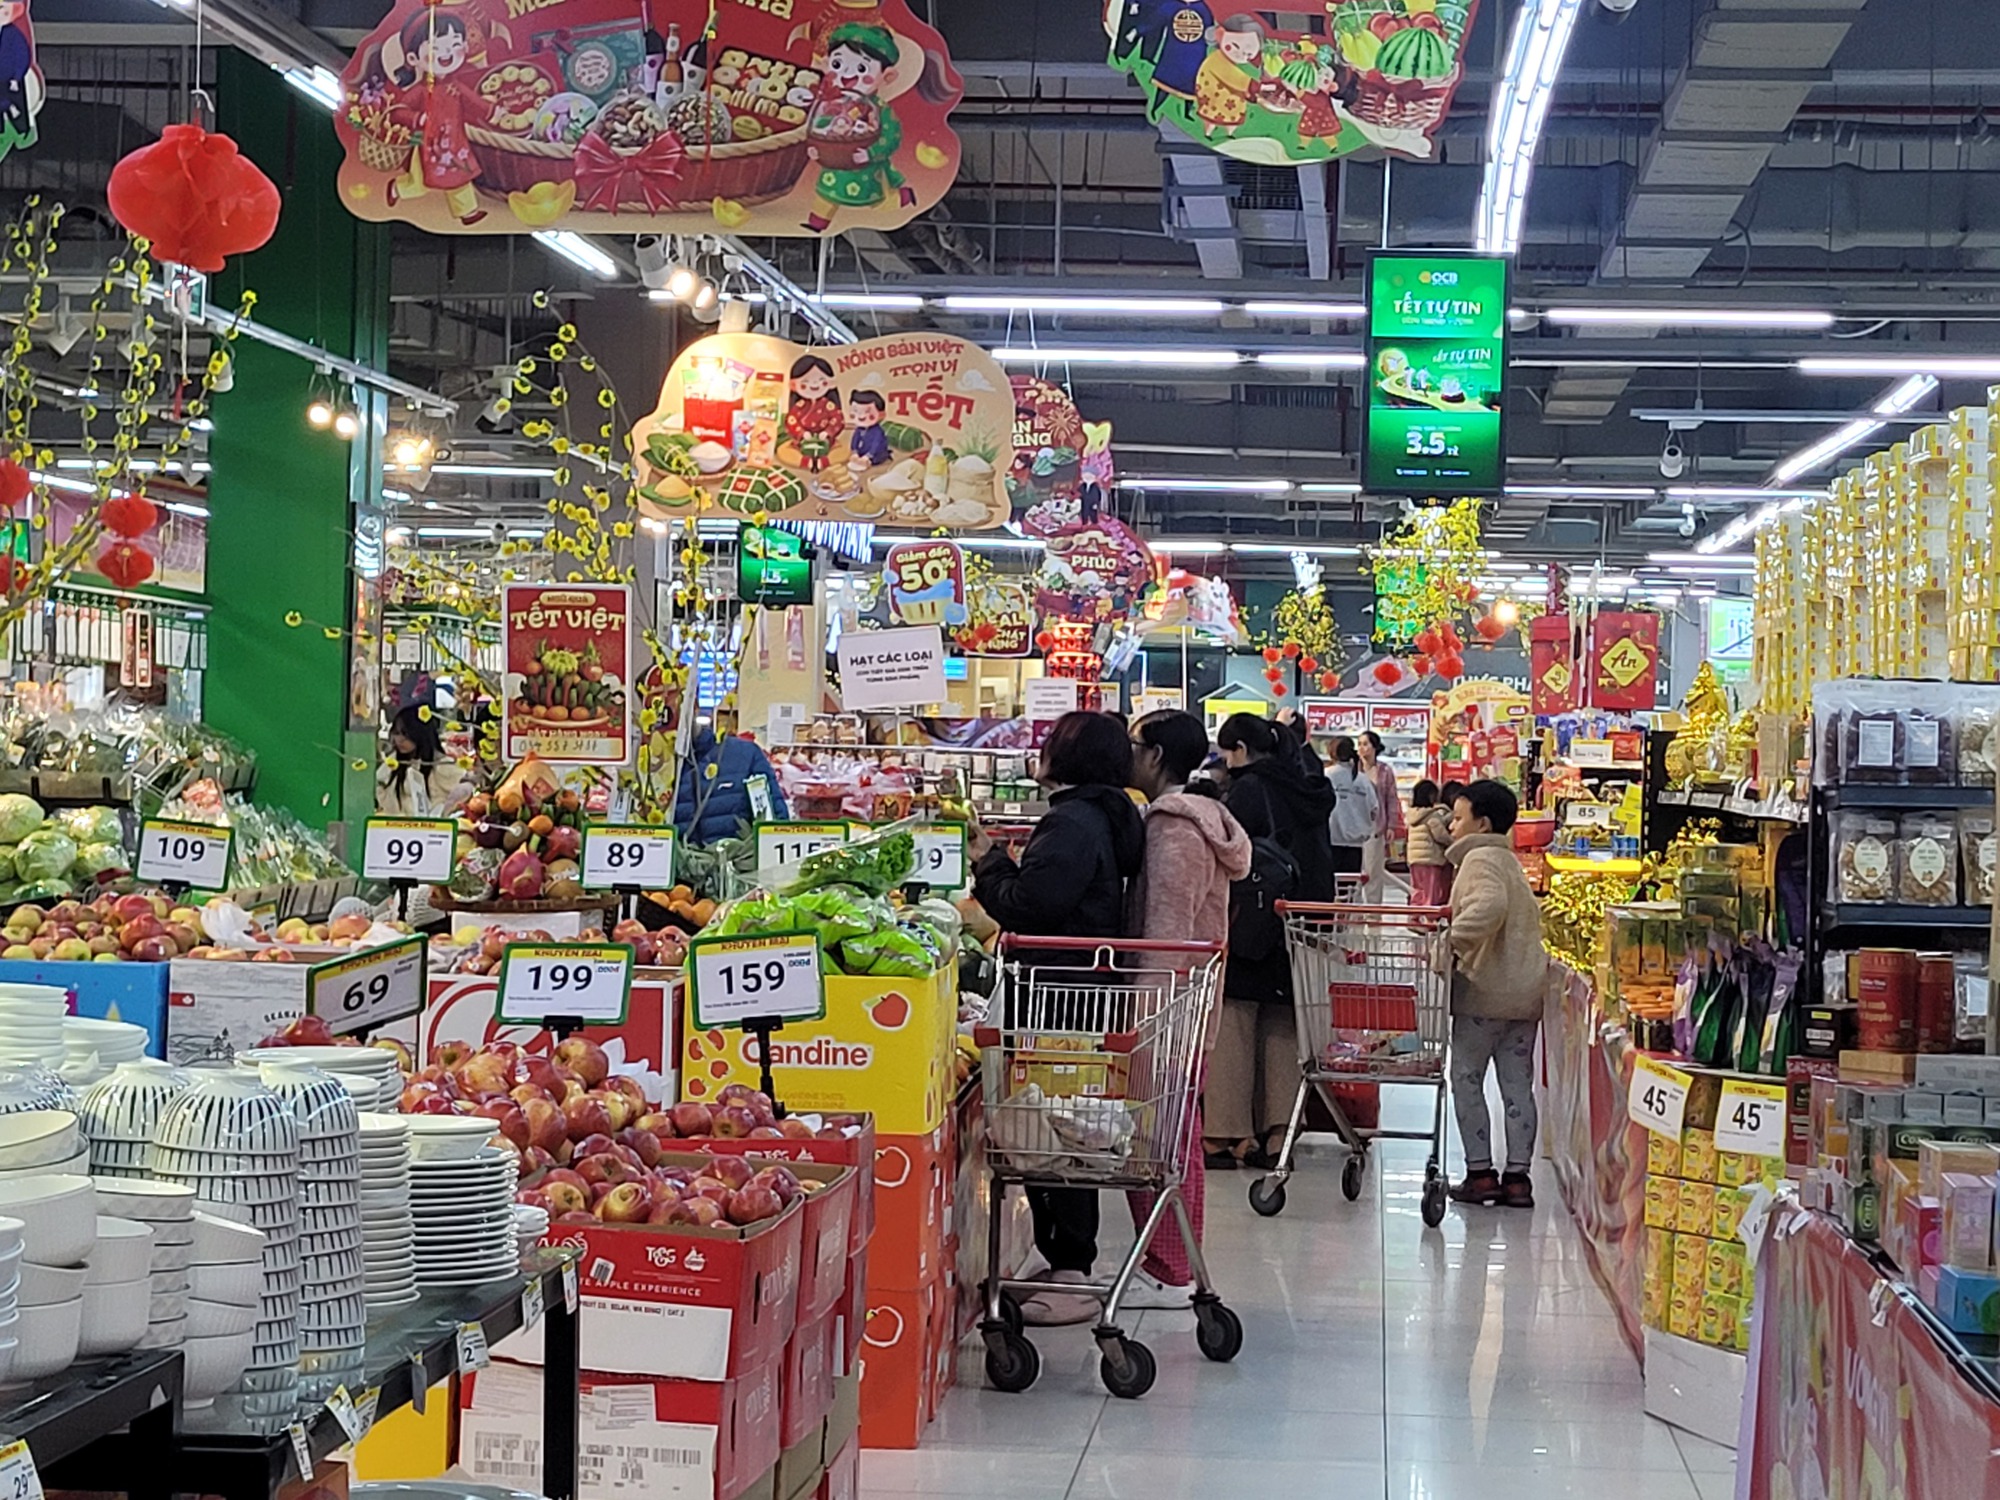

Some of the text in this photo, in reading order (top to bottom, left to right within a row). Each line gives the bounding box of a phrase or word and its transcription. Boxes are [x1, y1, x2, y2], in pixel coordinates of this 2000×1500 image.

[1393, 291, 1482, 318] TẾT TỰ TIN
[837, 340, 964, 373] NÔNG SẢN VIỆT
[1468, 348, 1491, 360] TIN
[941, 359, 958, 377] VỊ
[888, 375, 975, 430] TẾT
[1012, 420, 1031, 433] N
[1406, 431, 1445, 455] 3.5
[510, 601, 626, 636] TẾT VIỆT
[849, 650, 933, 668] HẠT CÁC LOẠI
[158, 836, 205, 862] 109
[387, 839, 424, 865] 99
[607, 842, 644, 867] 89
[528, 964, 592, 991] 199
[719, 961, 784, 995] 159
[343, 974, 389, 1012] 69
[742, 1036, 868, 1067] Candine
[1642, 1085, 1668, 1116] 45
[1732, 1101, 1762, 1131] 45
[633, 1283, 702, 1297] EXPERIENCE
[14, 1473, 29, 1499] 29
